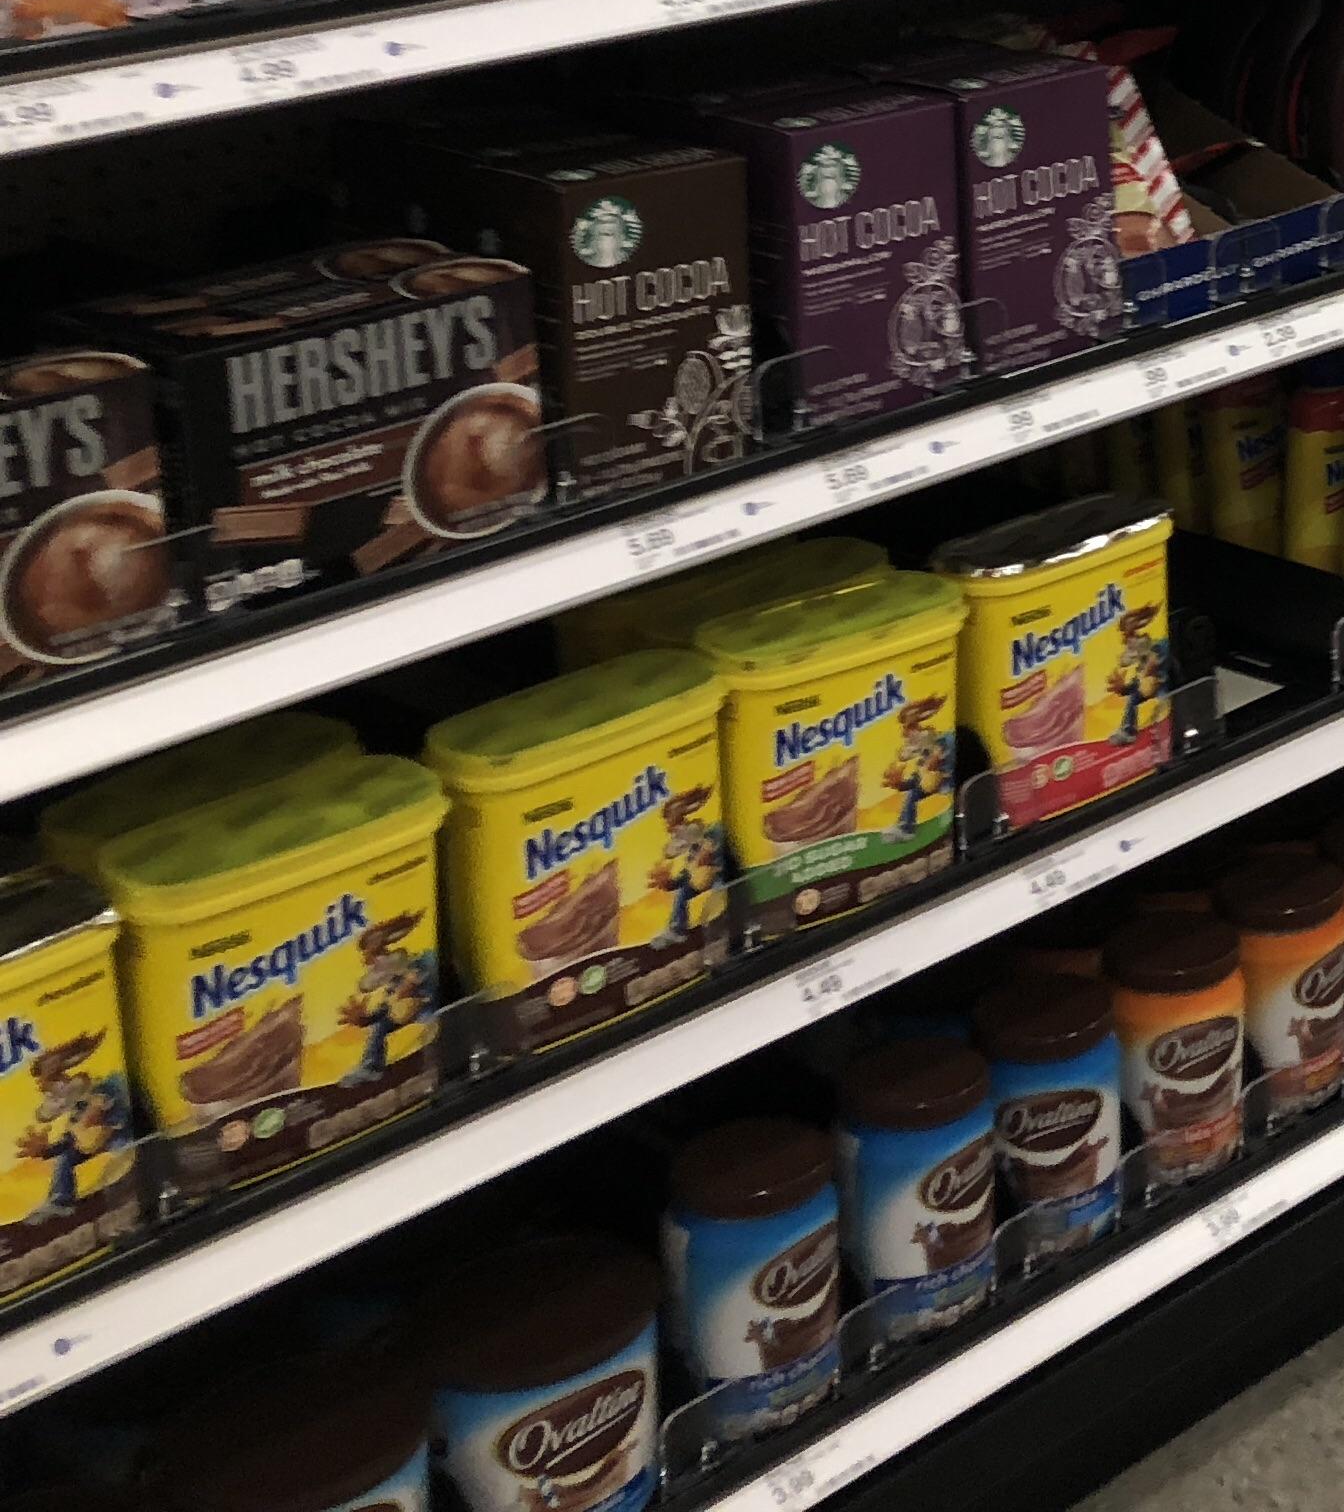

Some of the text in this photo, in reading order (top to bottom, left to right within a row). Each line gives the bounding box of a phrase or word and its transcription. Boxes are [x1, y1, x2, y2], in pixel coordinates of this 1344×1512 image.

[800, 195, 941, 262] HOT COCOA
[972, 155, 1099, 219] HOT COCOA
[572, 256, 731, 325] HOT COCOA
[225, 294, 498, 434] HERSHEY'S
[1012, 581, 1127, 678] Nesquik
[773, 671, 906, 768] Nesquik
[524, 764, 671, 882] Nesquik
[190, 892, 370, 1019] Nesquik
[507, 1377, 643, 1470] Ovaltine
